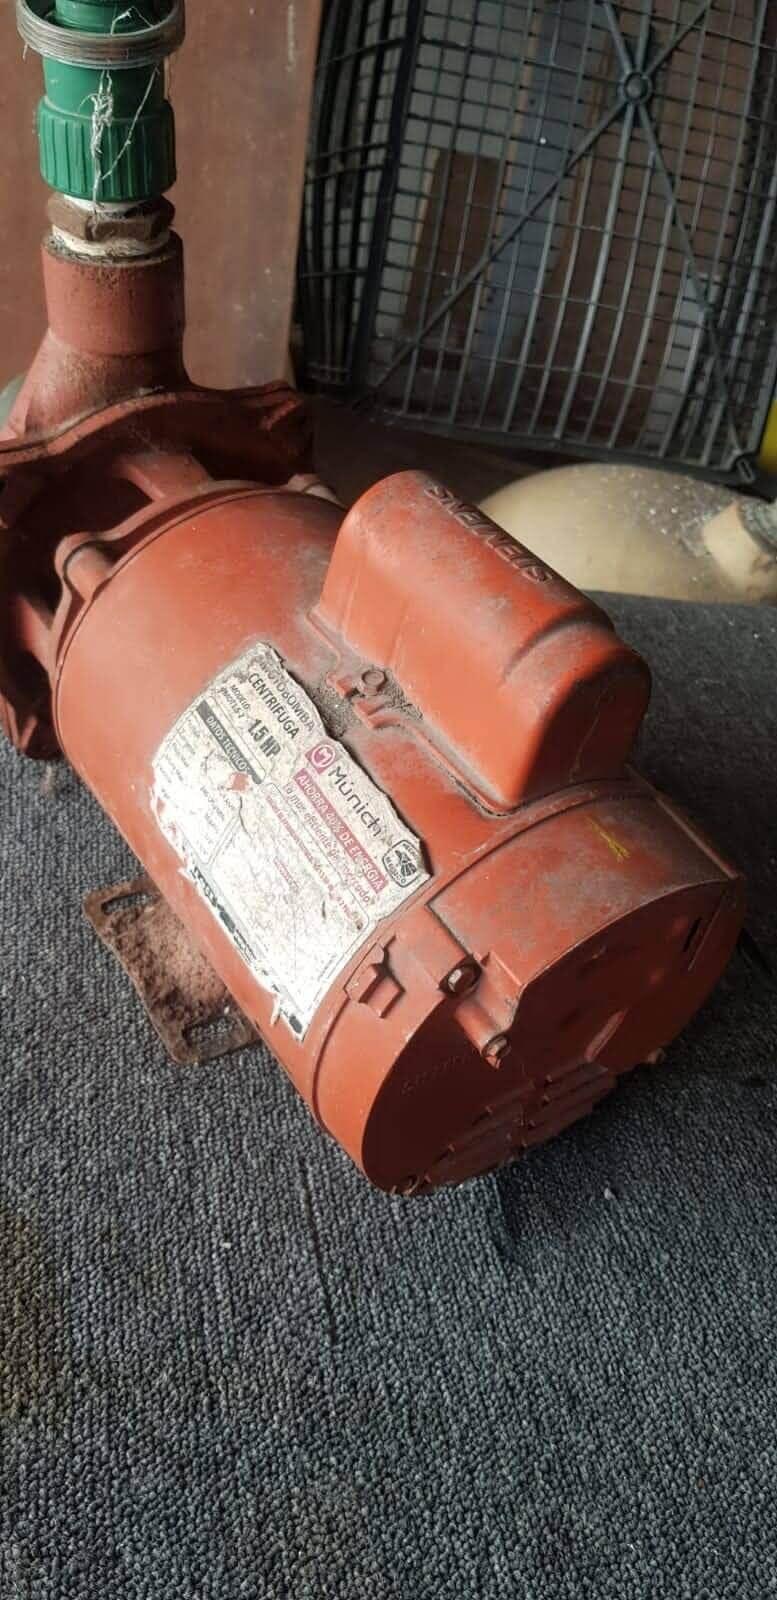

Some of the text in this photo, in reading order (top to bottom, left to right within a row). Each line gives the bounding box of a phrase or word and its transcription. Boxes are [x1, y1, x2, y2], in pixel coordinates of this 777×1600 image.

[205, 714, 226, 740] DATOS
[248, 673, 300, 739] CENTRIFUGA
[248, 719, 281, 757] 1.5 HP
[297, 774, 330, 814] AHORRA
[324, 810, 343, 833] 40%
[338, 830, 353, 847] DE
[328, 766, 382, 837] Múnich
